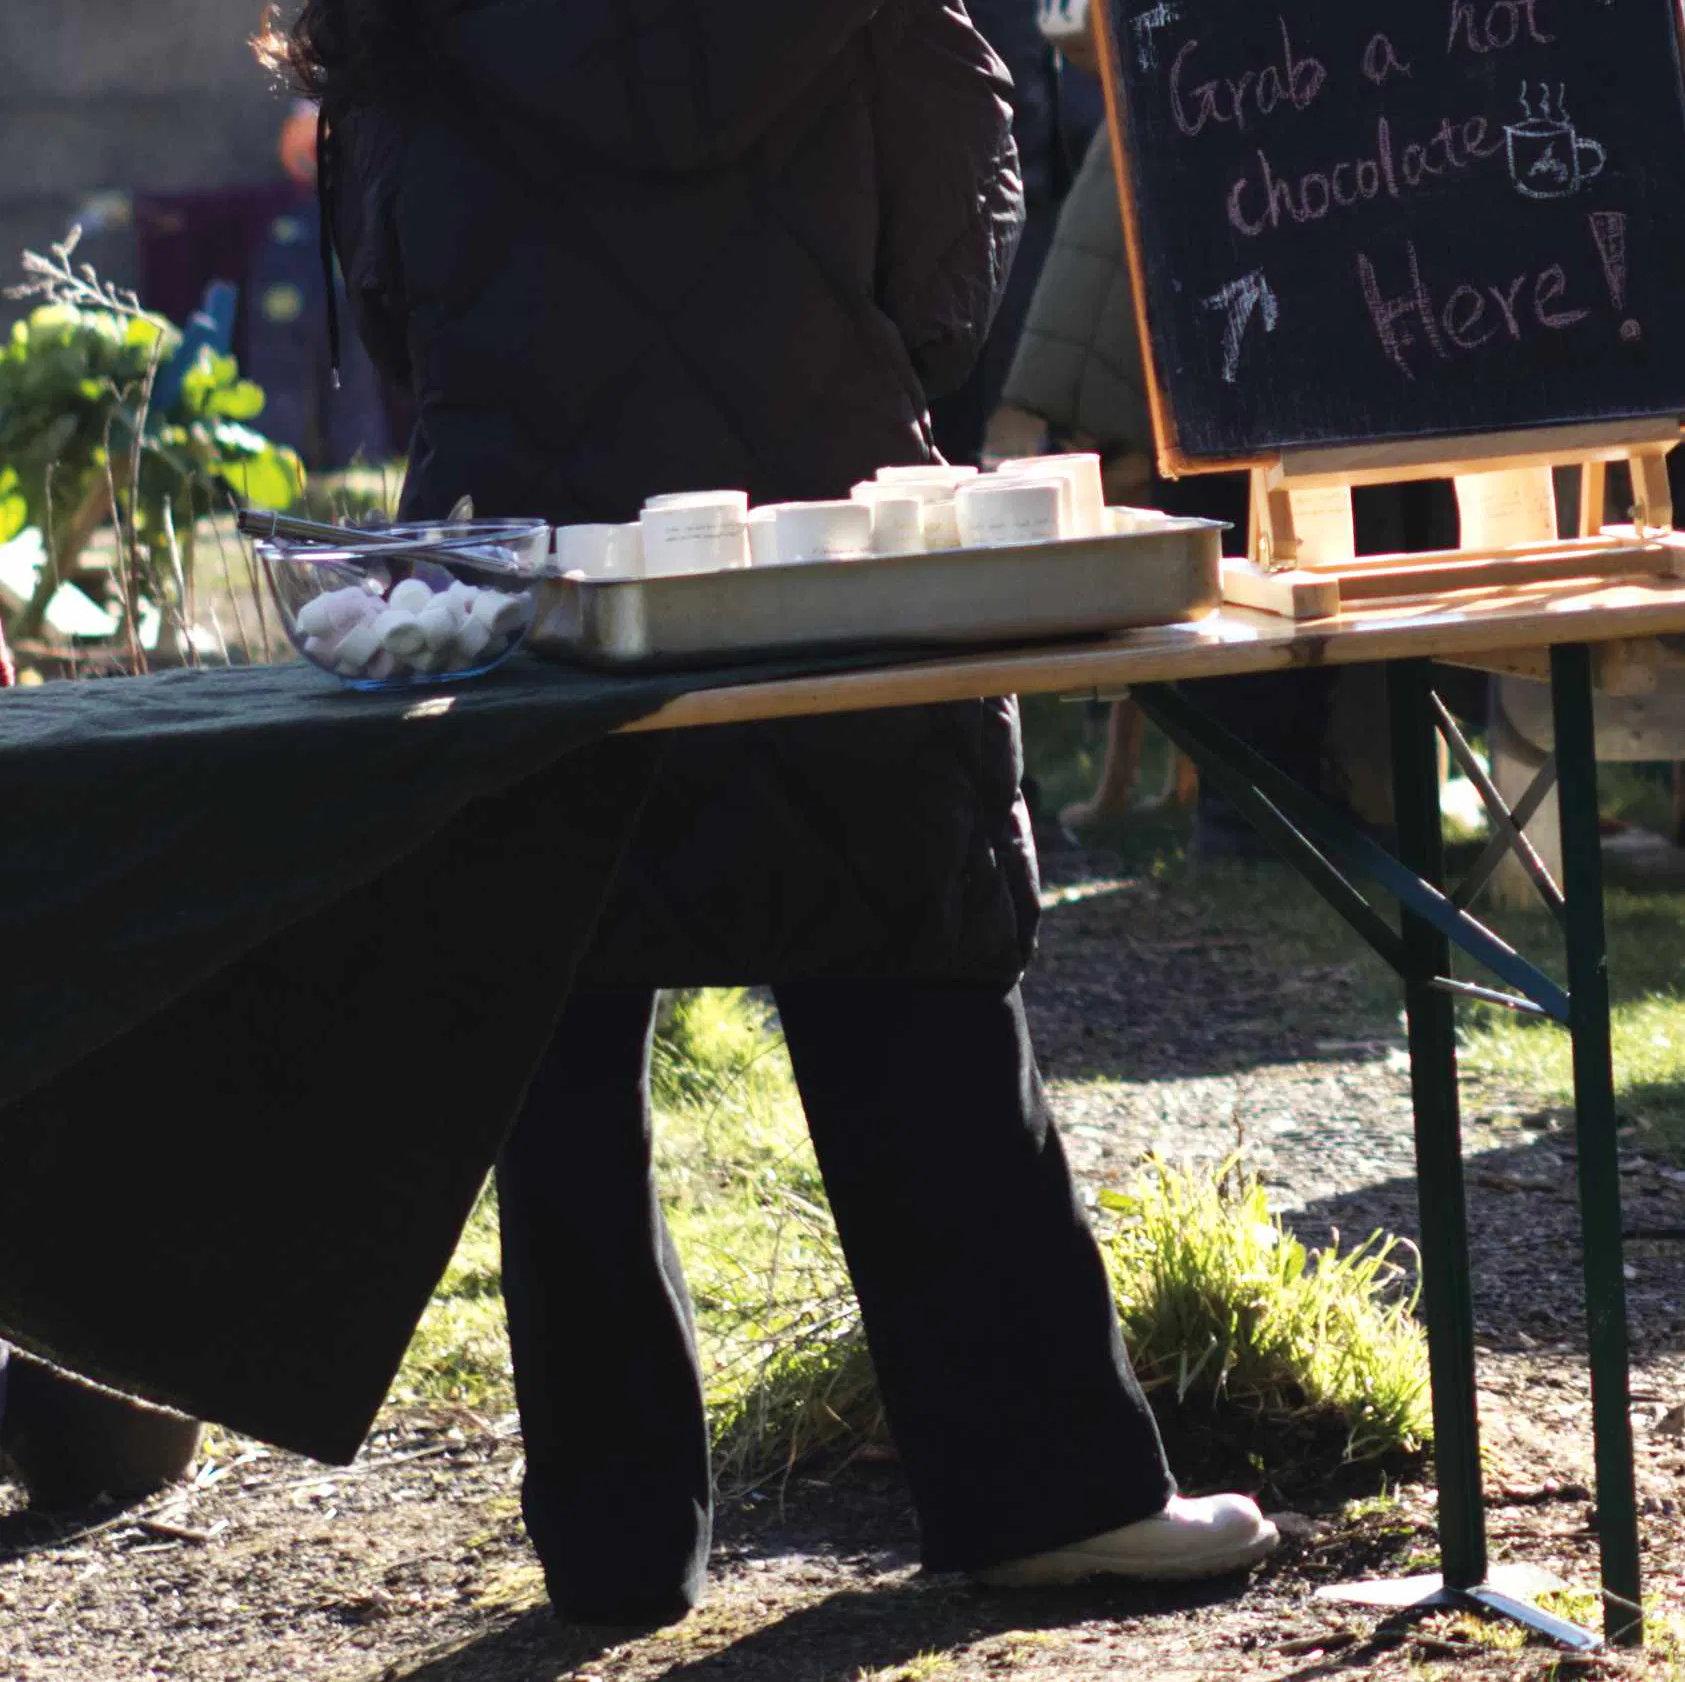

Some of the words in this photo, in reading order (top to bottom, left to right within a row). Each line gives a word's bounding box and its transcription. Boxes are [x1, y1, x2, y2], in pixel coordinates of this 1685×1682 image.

[1169, 15, 1328, 137] Grab
[1362, 33, 1413, 86] a
[1227, 117, 1502, 236] chocolate
[1357, 211, 1642, 381] Here!
